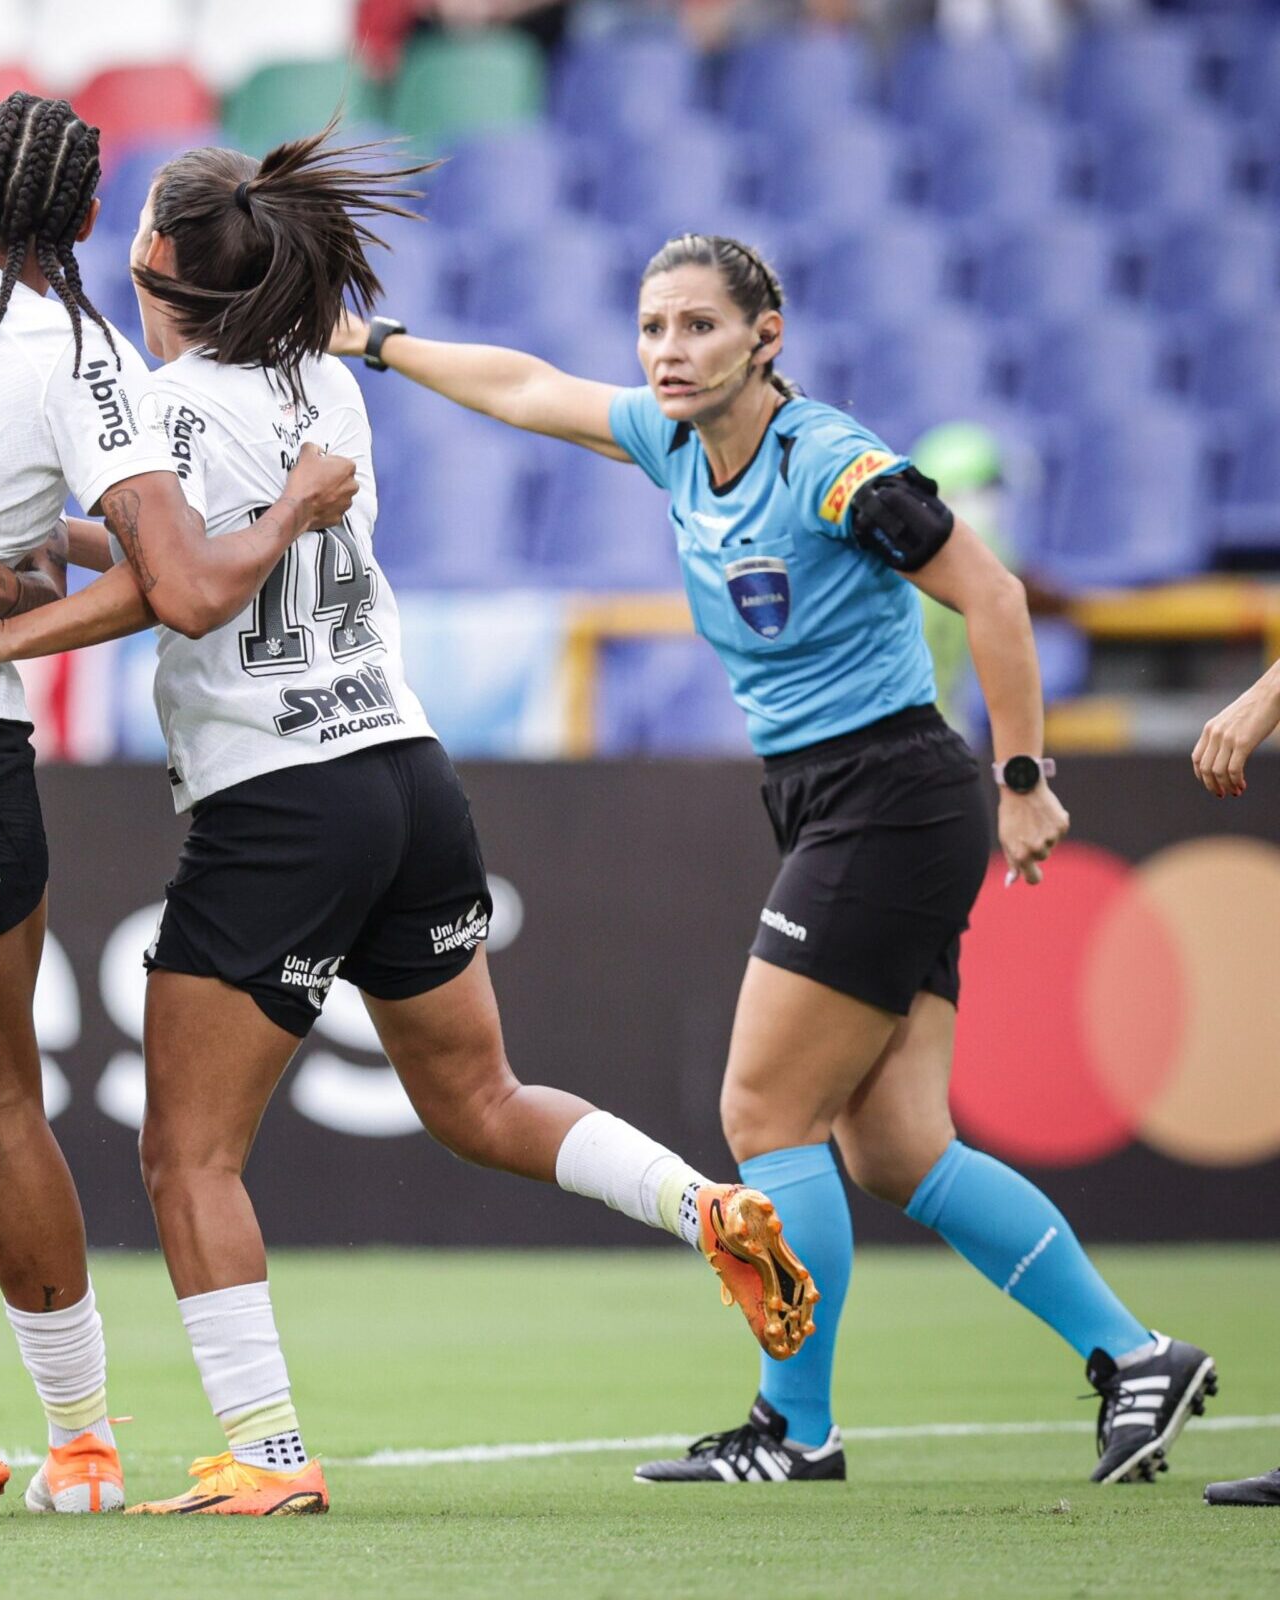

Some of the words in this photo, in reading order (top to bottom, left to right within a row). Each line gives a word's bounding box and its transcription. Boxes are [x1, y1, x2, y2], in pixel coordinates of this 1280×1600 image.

[90, 379, 132, 451] bmg
[237, 506, 387, 677] 14
[320, 713, 405, 743] ATACADISTA
[430, 922, 454, 942] Uni
[284, 955, 311, 972] Uni
